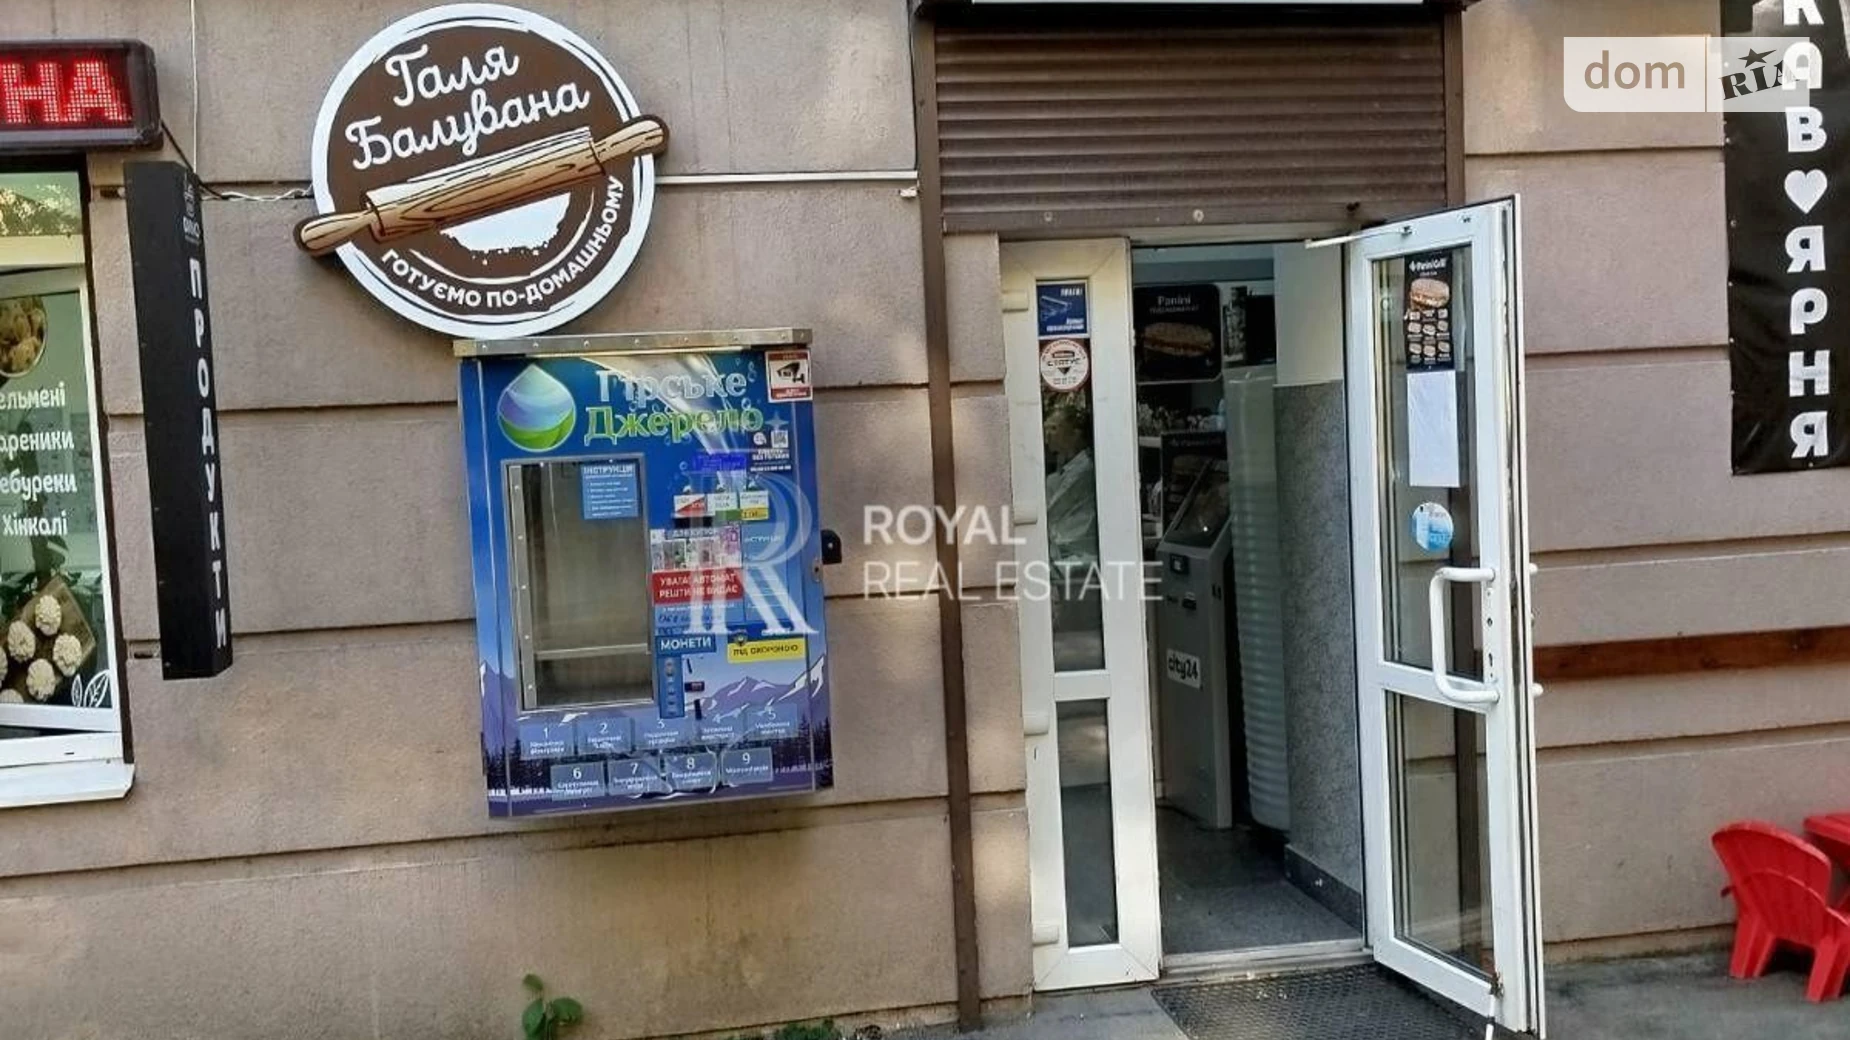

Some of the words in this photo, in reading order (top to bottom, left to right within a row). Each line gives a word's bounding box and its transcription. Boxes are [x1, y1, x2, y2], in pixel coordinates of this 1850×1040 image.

[385, 44, 520, 107] Галя
[345, 82, 591, 170] Балувана
[381, 249, 482, 307] ГОТУЄМО
[486, 176, 625, 308] ПО-ДОМАШНЬОМУ
[584, 406, 764, 447] Джерело
[188, 257, 227, 649] ПРОДУКТИ
[2, 510, 68, 536] Хінкалі
[660, 636, 712, 651] МОНЕТИ
[1168, 655, 1200, 680] city24
[686, 757, 696, 769] 8
[742, 752, 751, 764] 9
[573, 767, 582, 780] 6
